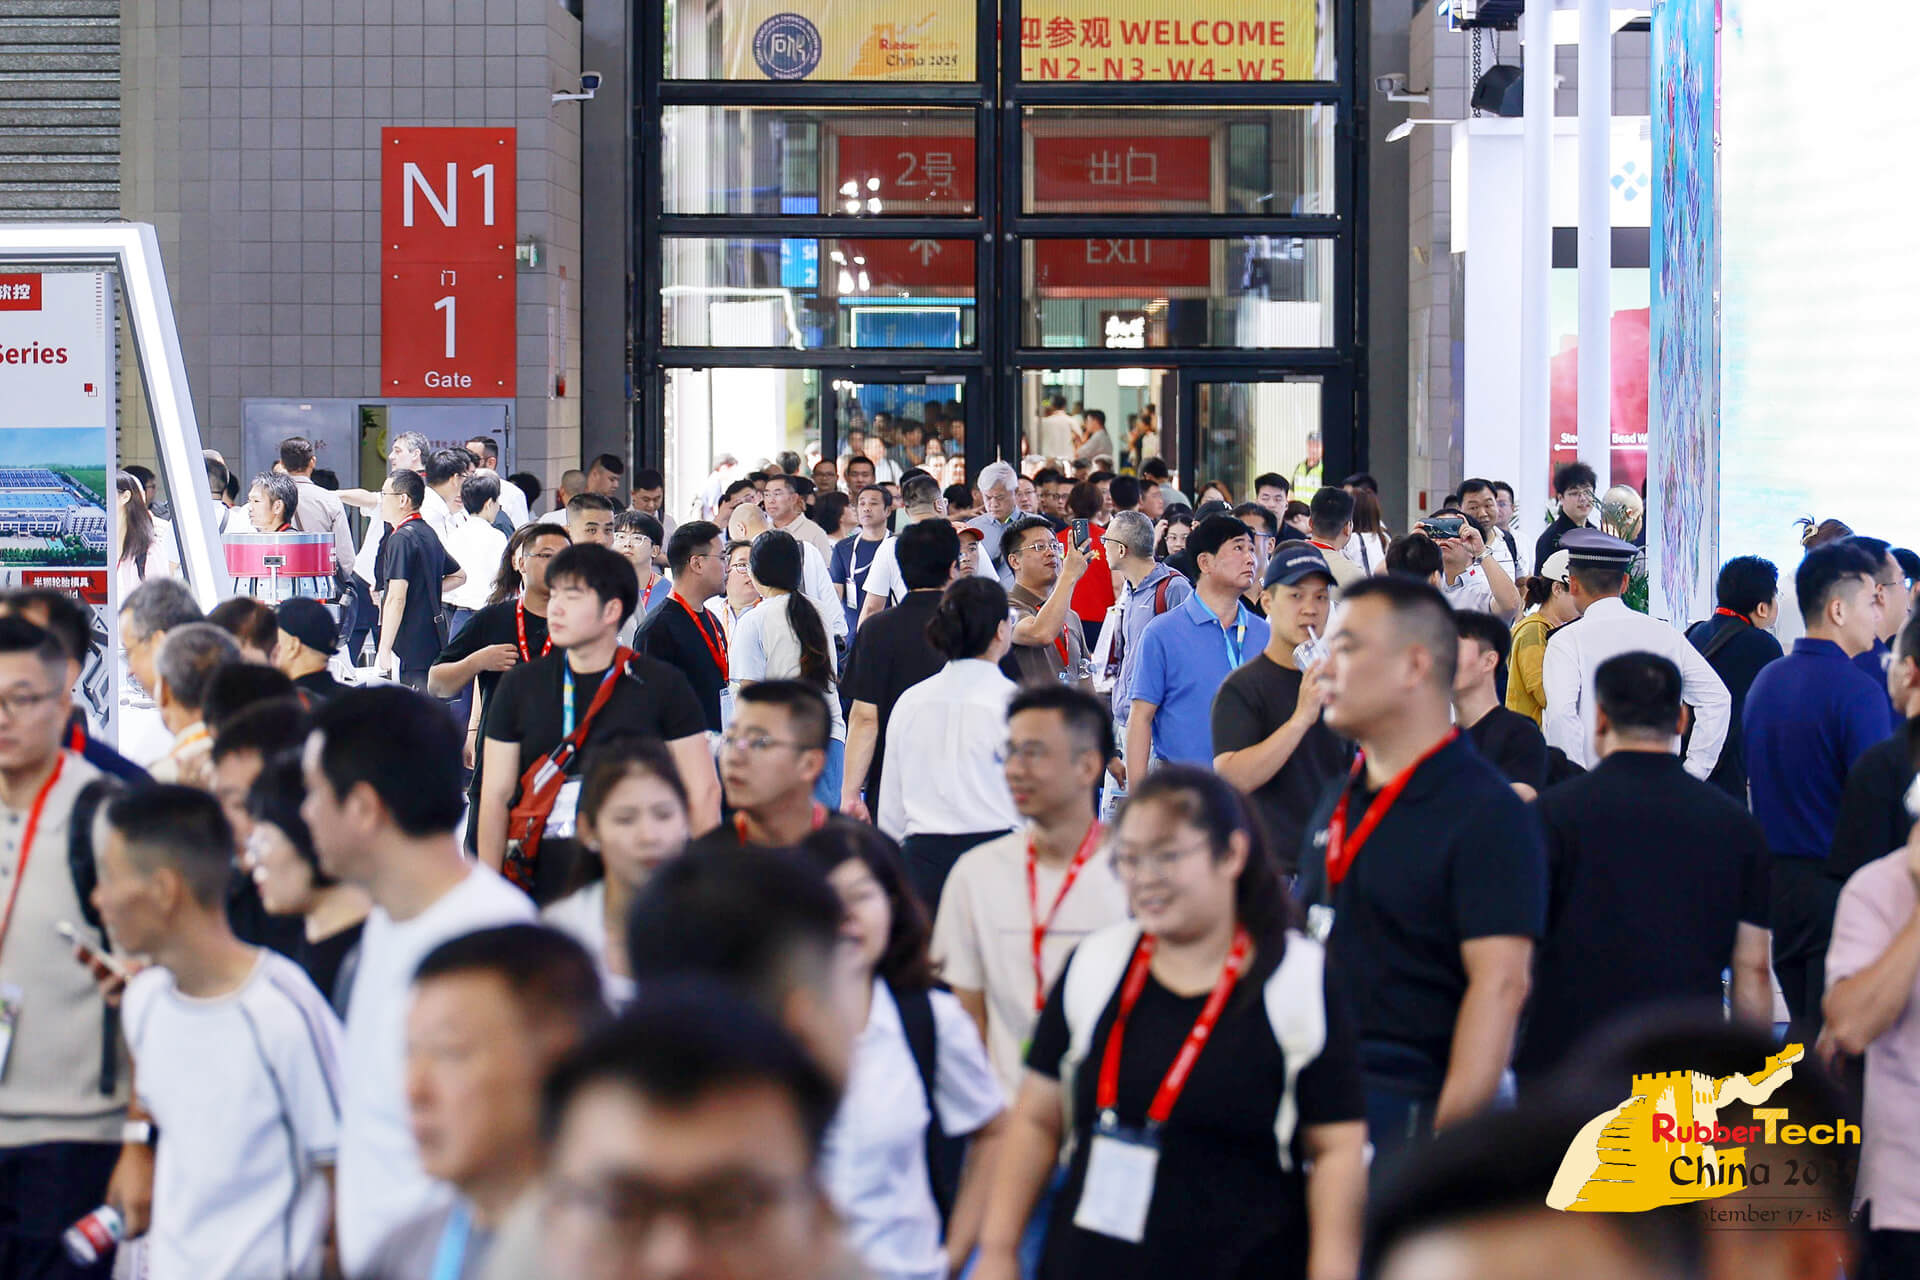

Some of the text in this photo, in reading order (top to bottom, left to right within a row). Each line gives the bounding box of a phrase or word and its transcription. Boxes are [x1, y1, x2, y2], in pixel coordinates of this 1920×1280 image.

[1120, 20, 1285, 46] WELCOME
[886, 53, 925, 67] China
[896, 151, 957, 187] 2号
[1089, 146, 1157, 185] 出口
[403, 162, 495, 228] N1
[440, 270, 456, 286] 门
[433, 296, 456, 359] 1
[424, 371, 473, 389] Gate
[1612, 433, 1637, 444] Bead
